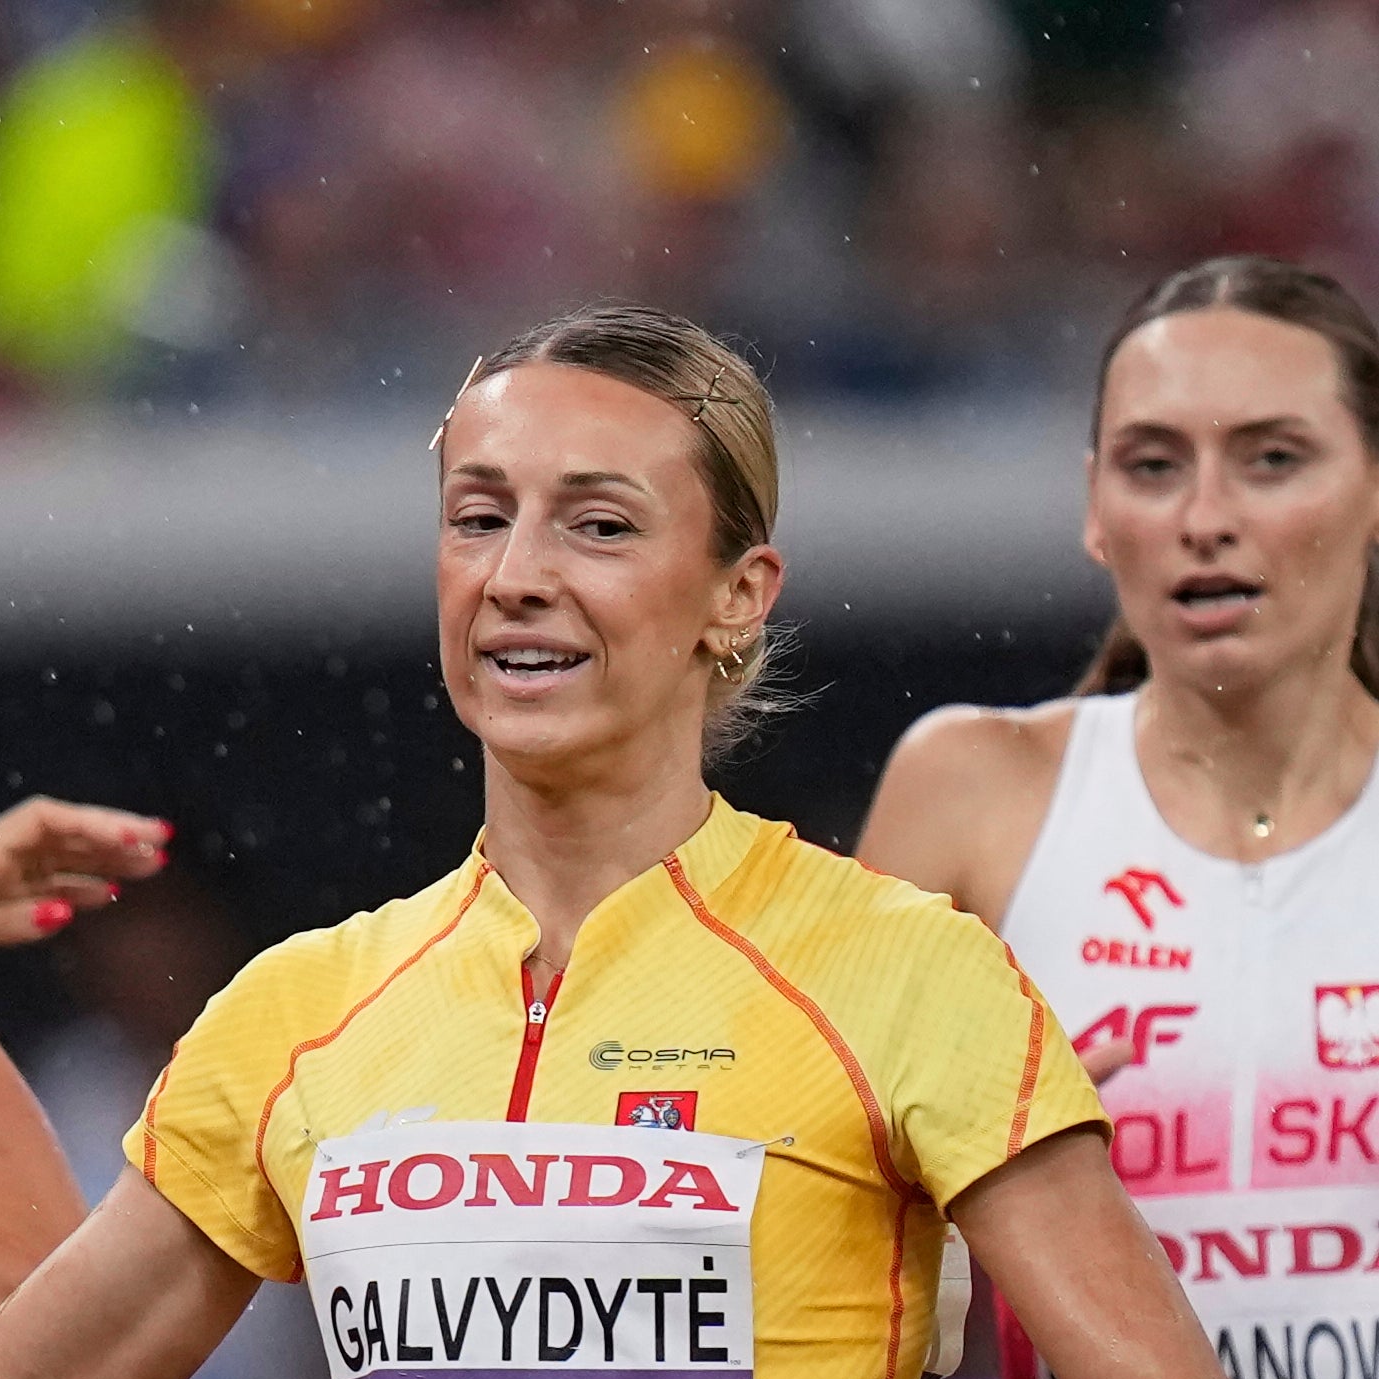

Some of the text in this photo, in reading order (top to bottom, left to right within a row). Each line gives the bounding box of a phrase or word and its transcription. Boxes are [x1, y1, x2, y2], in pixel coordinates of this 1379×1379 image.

[1081, 938, 1192, 969] ORLEN
[592, 1043, 736, 1067] COSMA
[309, 1153, 740, 1222] HONDA
[330, 1256, 729, 1372] GALVYDYTĖ
